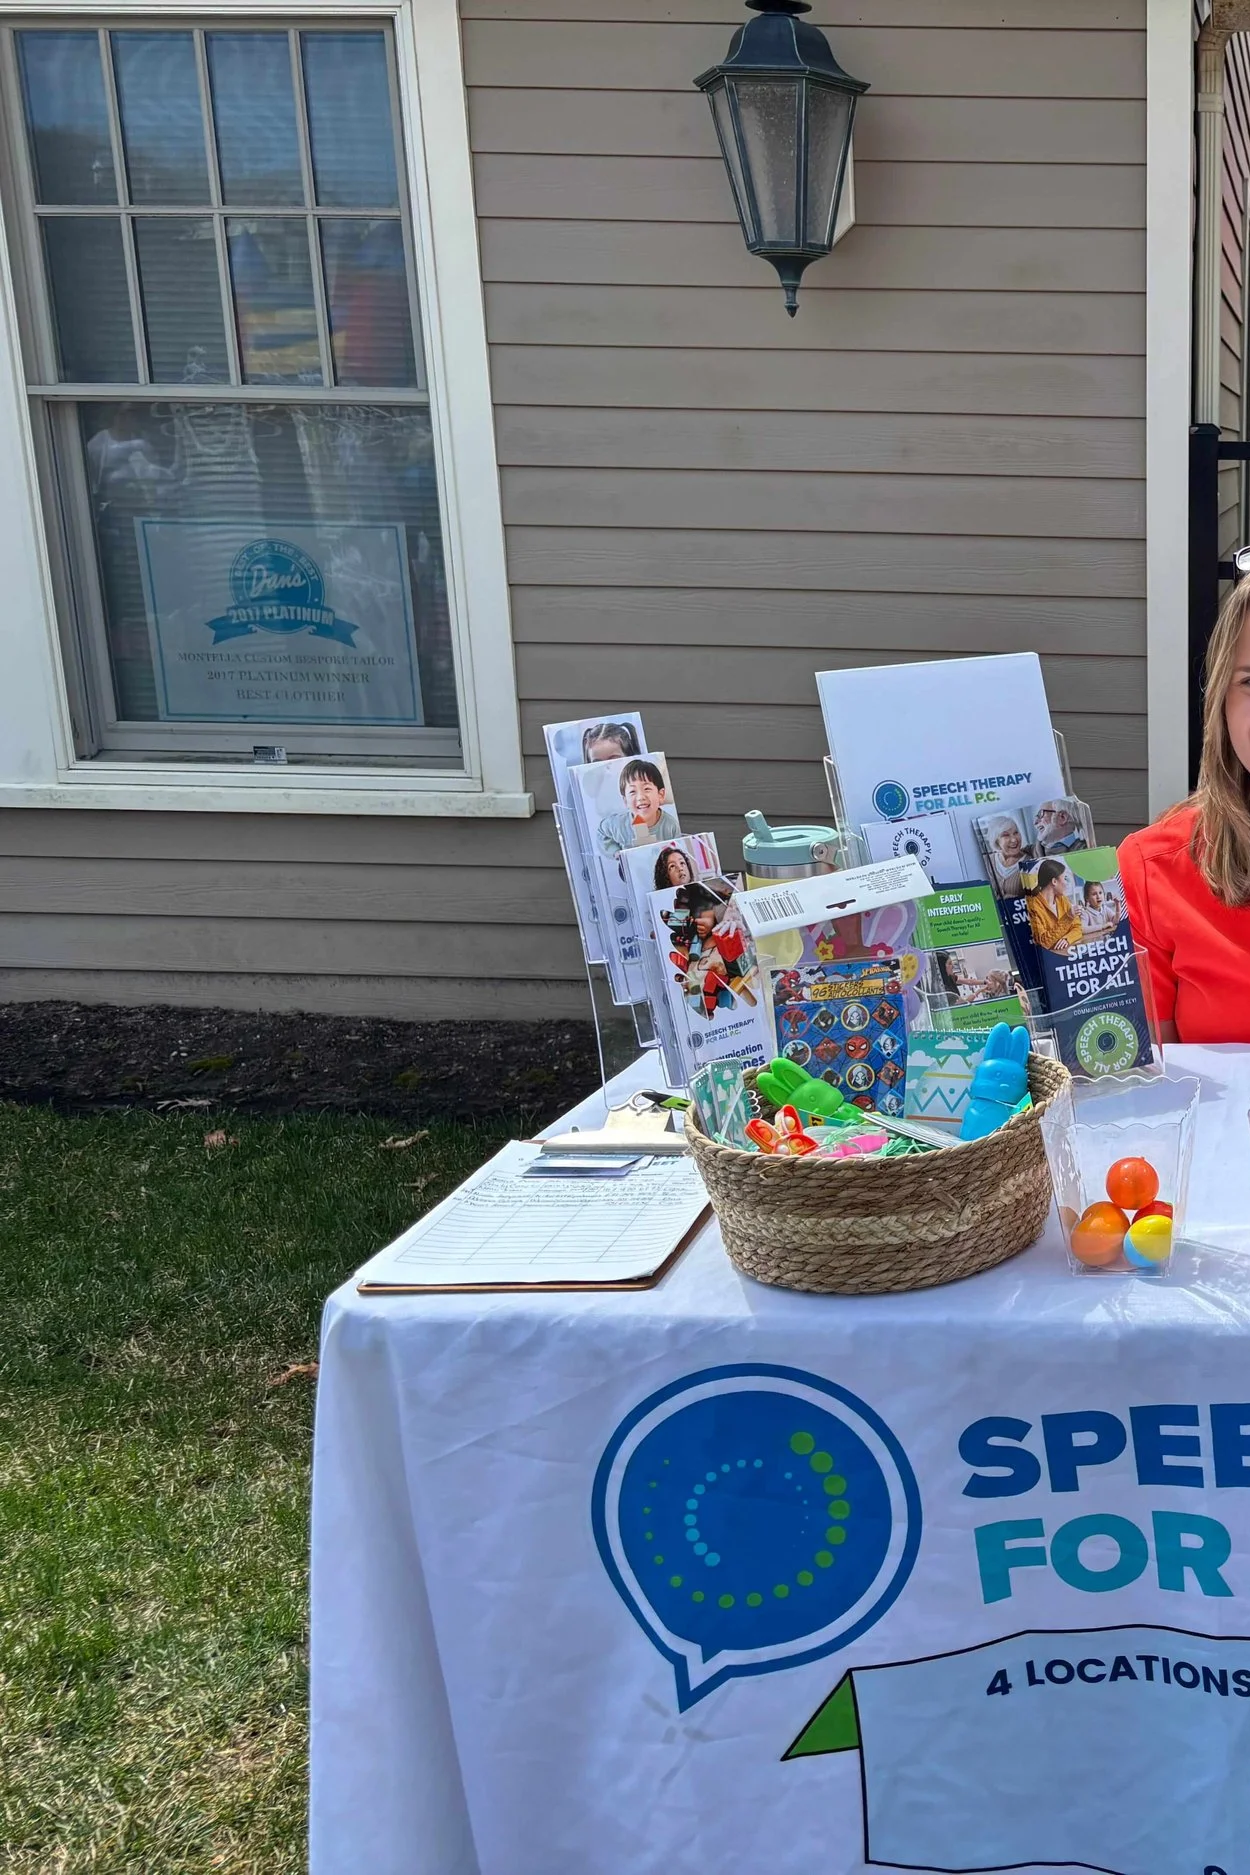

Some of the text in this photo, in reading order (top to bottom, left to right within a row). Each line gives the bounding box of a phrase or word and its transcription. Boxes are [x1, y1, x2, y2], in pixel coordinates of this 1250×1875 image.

[253, 543, 265, 554] OF
[273, 543, 294, 556] THE
[231, 605, 335, 626] 2017 PLATINUM
[244, 653, 291, 663] CUSTOM
[296, 655, 349, 664] BESPOKE
[352, 657, 395, 666] TAILOR
[207, 670, 370, 684] 2017 PLATINUM WINNER
[236, 689, 345, 702] BEST CLOTHIER
[912, 772, 1032, 799] SPEECH THERAPY
[915, 791, 1000, 812] FOR ALL P.C.
[904, 827, 932, 854] THERAPY
[940, 893, 964, 904] EARLY
[927, 903, 982, 917] INTERVENTION
[1067, 936, 1128, 961] SPEECH
[1055, 953, 1130, 981] THERAPY
[1067, 977, 1101, 998] FOR
[1105, 971, 1135, 990] ALL
[813, 987, 827, 999] 96
[828, 986, 884, 999] AUTOCOLLANTS
[1073, 1001, 1118, 1016] COMMUNICATION
[728, 1018, 755, 1030] THERAPY
[718, 1033, 729, 1041] ALL
[1080, 1015, 1135, 1074] SPEECH THERAPY FOR ALL
[973, 1511, 1235, 1604] FOR
[986, 1668, 1013, 1696] 4
